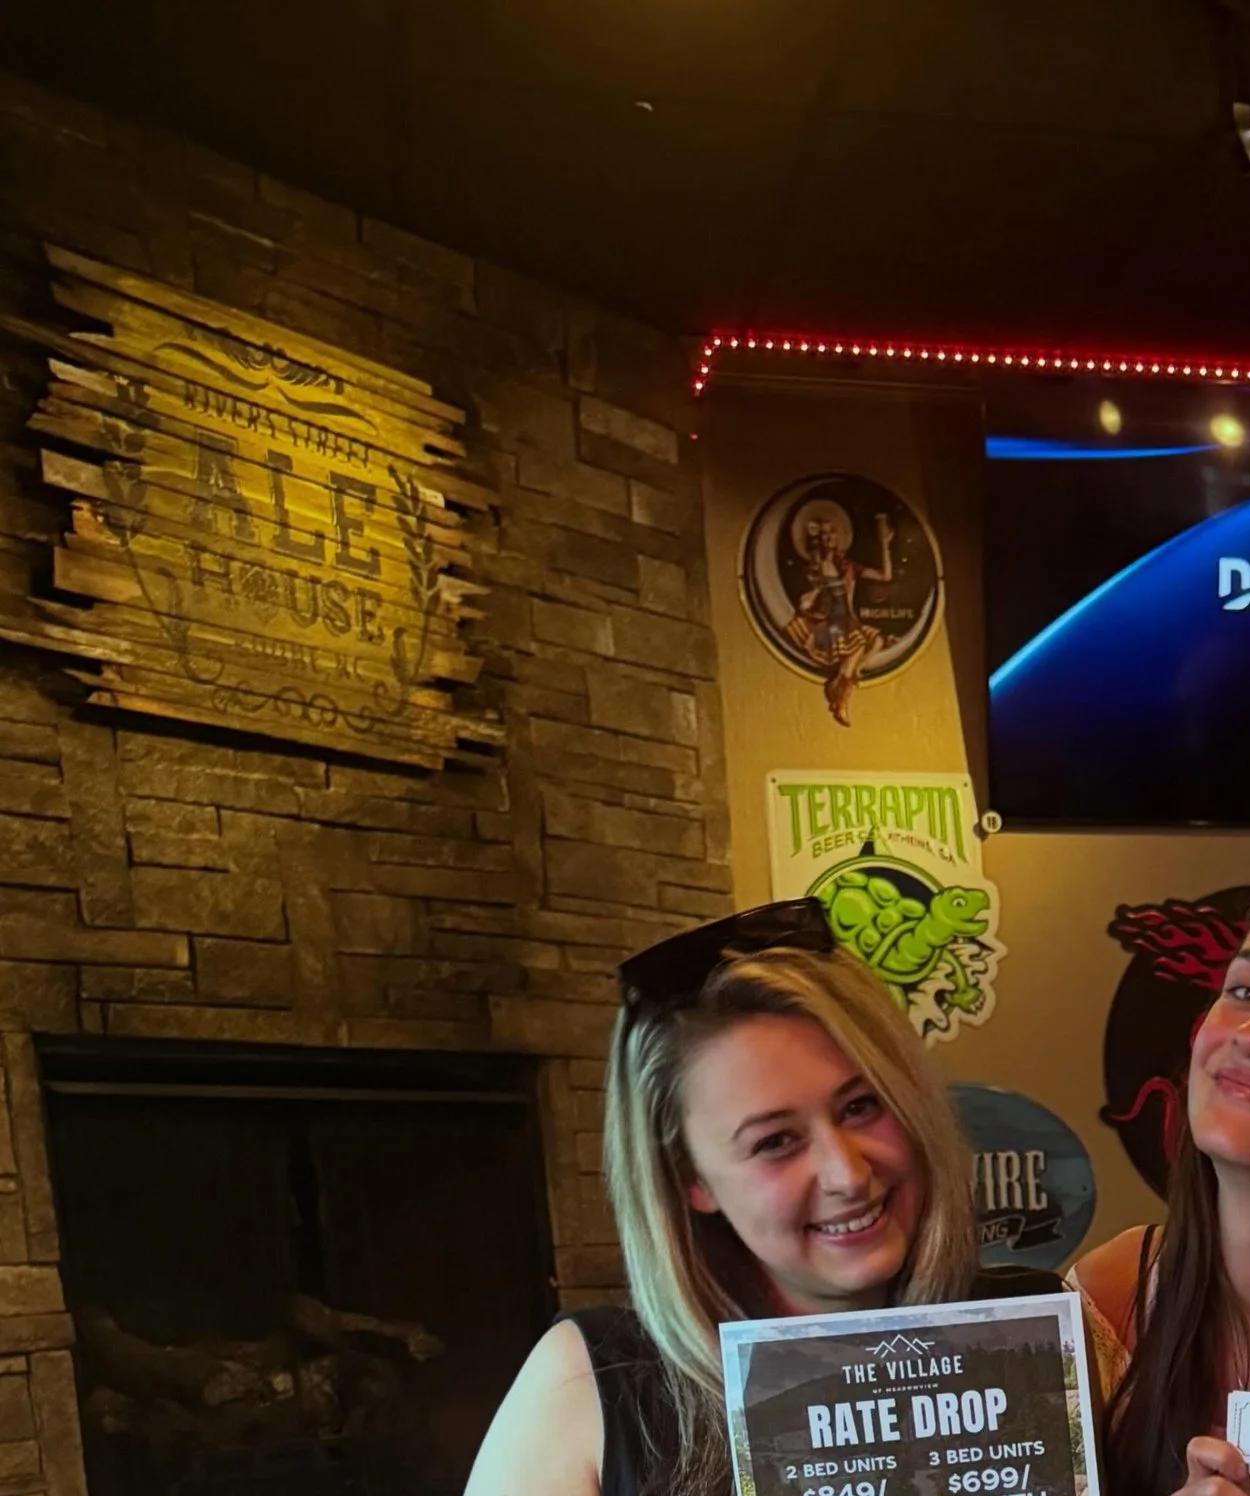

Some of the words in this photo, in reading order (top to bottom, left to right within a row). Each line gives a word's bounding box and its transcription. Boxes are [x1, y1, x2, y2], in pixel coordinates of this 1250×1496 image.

[195, 427, 382, 582] ALE
[188, 541, 385, 645] HOUSE
[777, 784, 968, 864] TERRAPIN
[811, 833, 854, 859] BEER
[842, 1363, 877, 1384] THE
[886, 1355, 963, 1380] VILLAGE
[807, 1398, 900, 1449] RATE
[911, 1388, 1008, 1439] DROP
[786, 1465, 797, 1480] 2
[803, 1462, 841, 1479] BED
[844, 1455, 897, 1474] UNITS
[929, 1452, 940, 1467] 3
[946, 1447, 983, 1465] BED
[988, 1441, 1045, 1461] UNITS
[948, 1464, 1031, 1494] $699/
